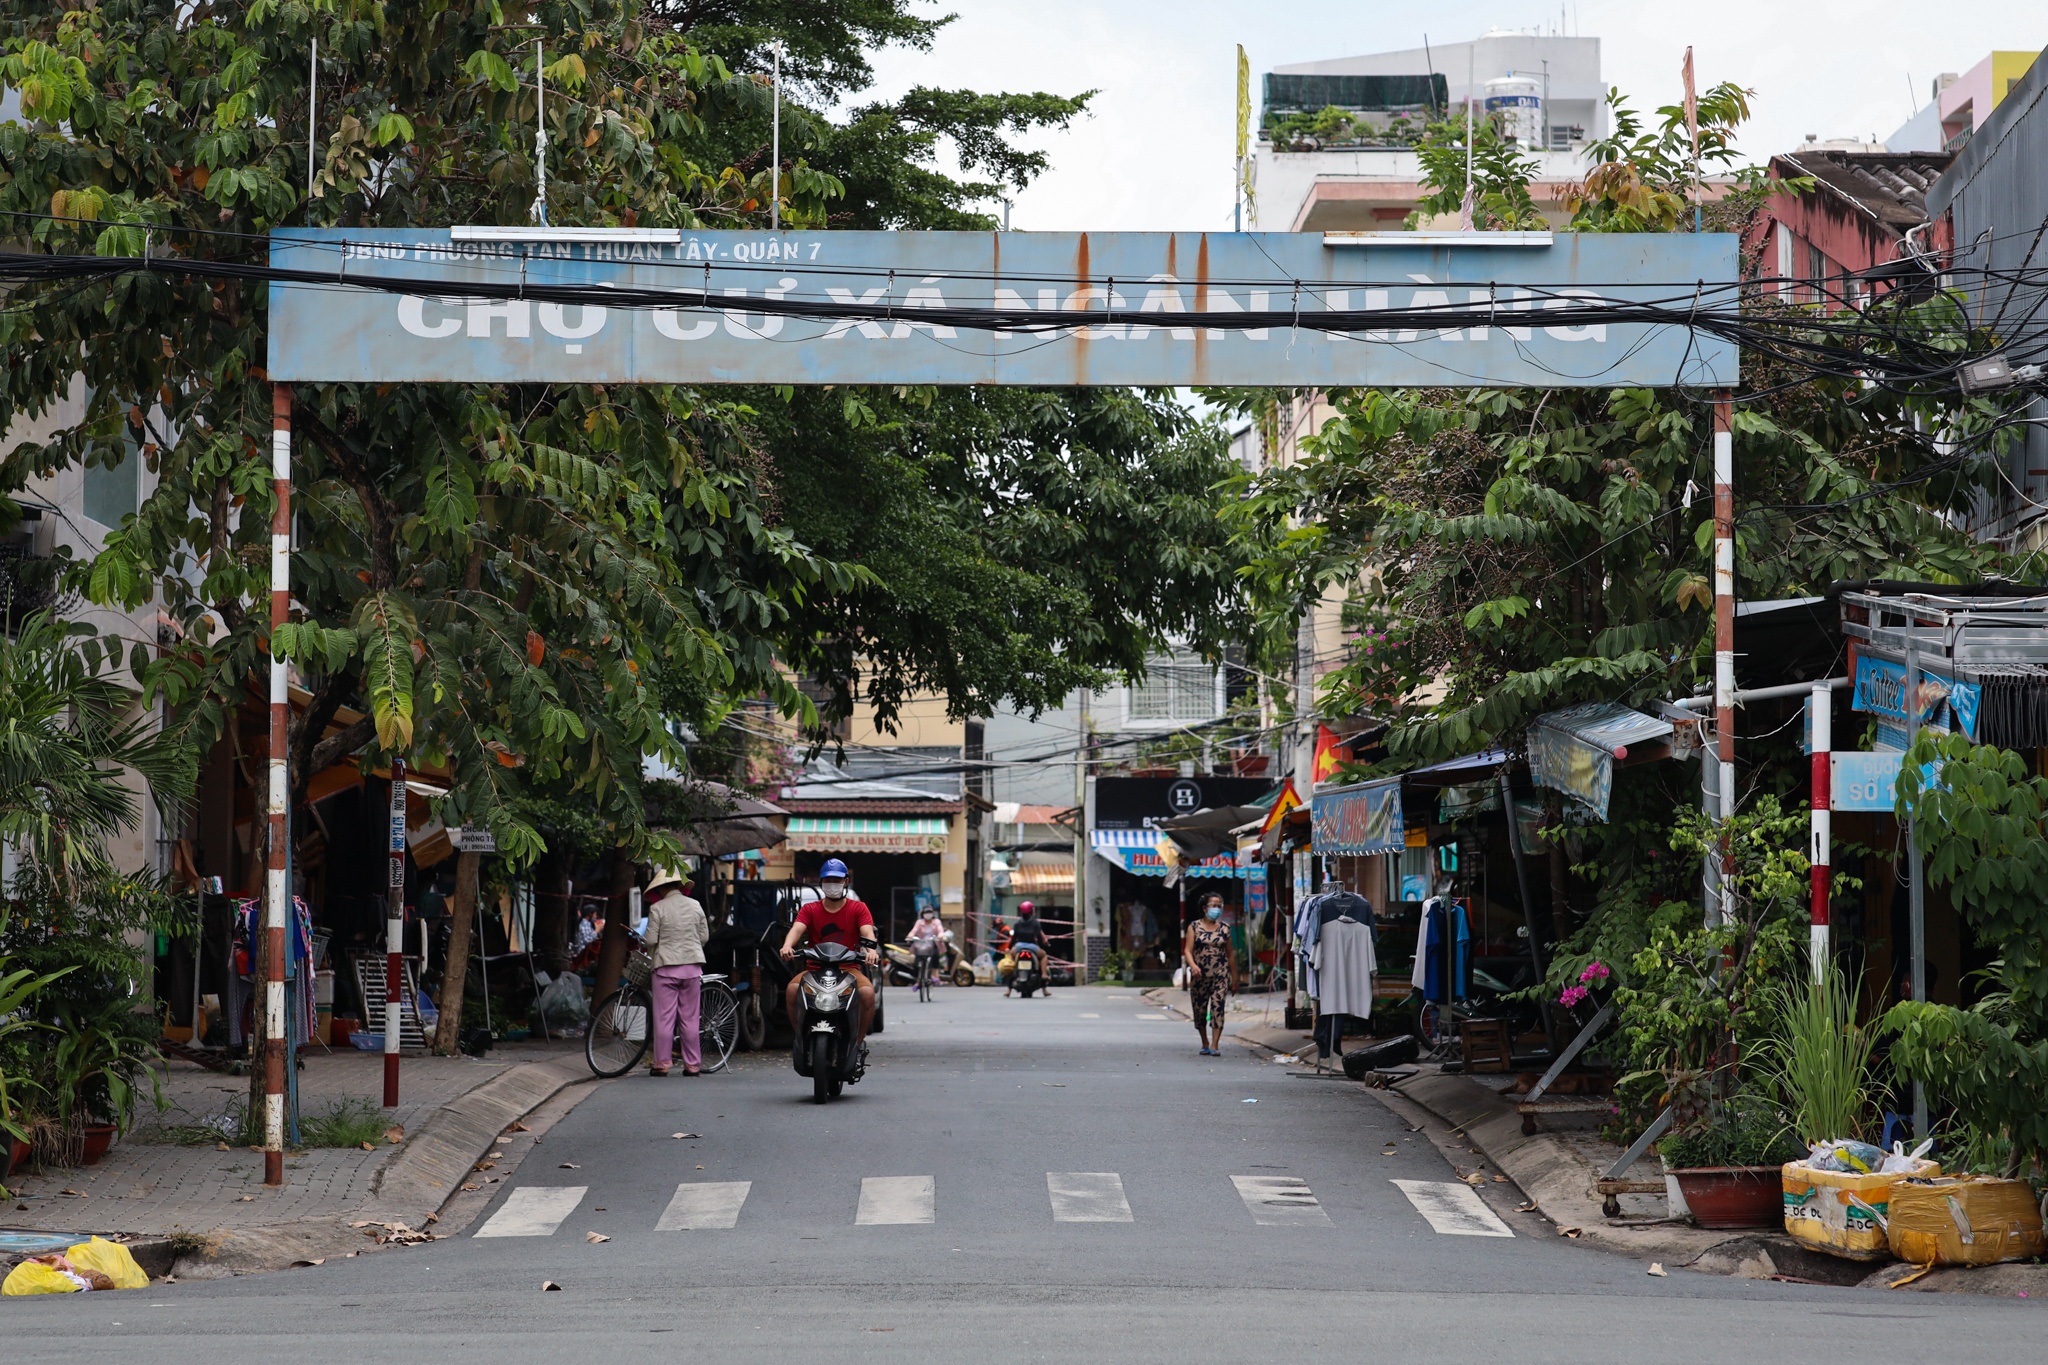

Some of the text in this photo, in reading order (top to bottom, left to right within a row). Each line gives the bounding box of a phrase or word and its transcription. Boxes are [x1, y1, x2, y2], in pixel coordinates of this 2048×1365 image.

[808, 242, 822, 260] 7
[821, 272, 959, 340] XÁ
[994, 273, 1270, 341] NGÂN
[1869, 667, 1900, 713] Coffee
[1849, 775, 1880, 801] SỐ
